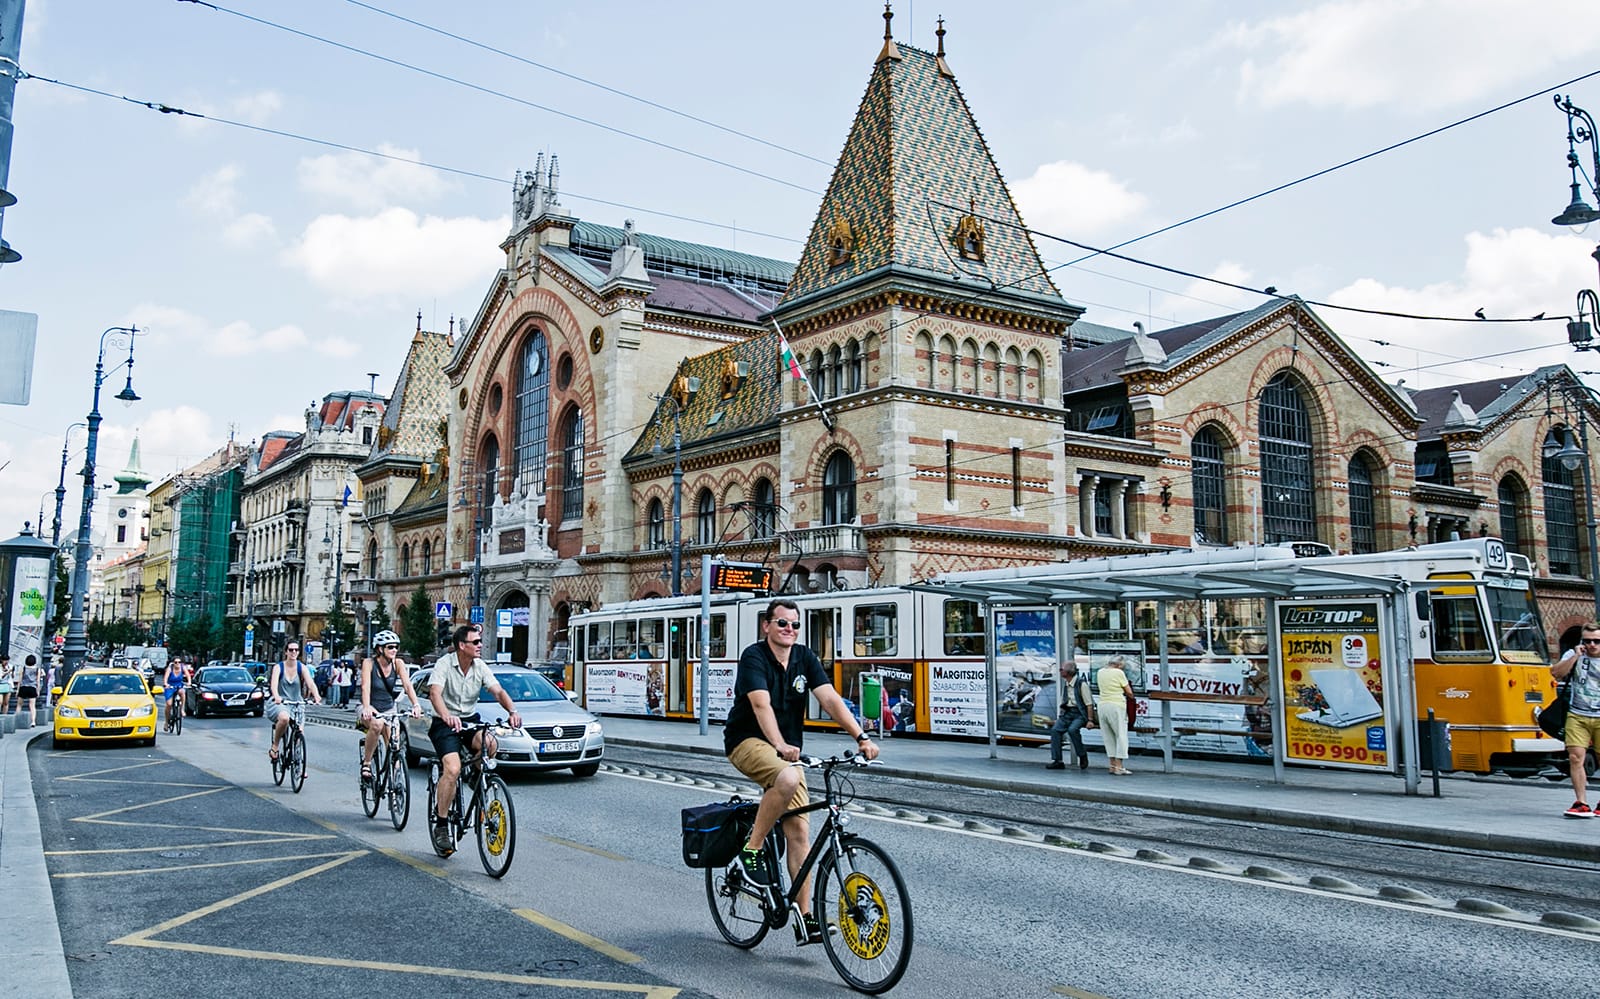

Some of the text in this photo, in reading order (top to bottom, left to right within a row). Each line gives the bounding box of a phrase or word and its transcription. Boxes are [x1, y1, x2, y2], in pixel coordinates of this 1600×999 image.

[1489, 545, 1503, 562] 49
[1287, 636, 1333, 656] JAPÁN
[1152, 674, 1240, 695] BNYOVSZKY
[1292, 743, 1326, 757] 109
[1330, 745, 1368, 761] 990
